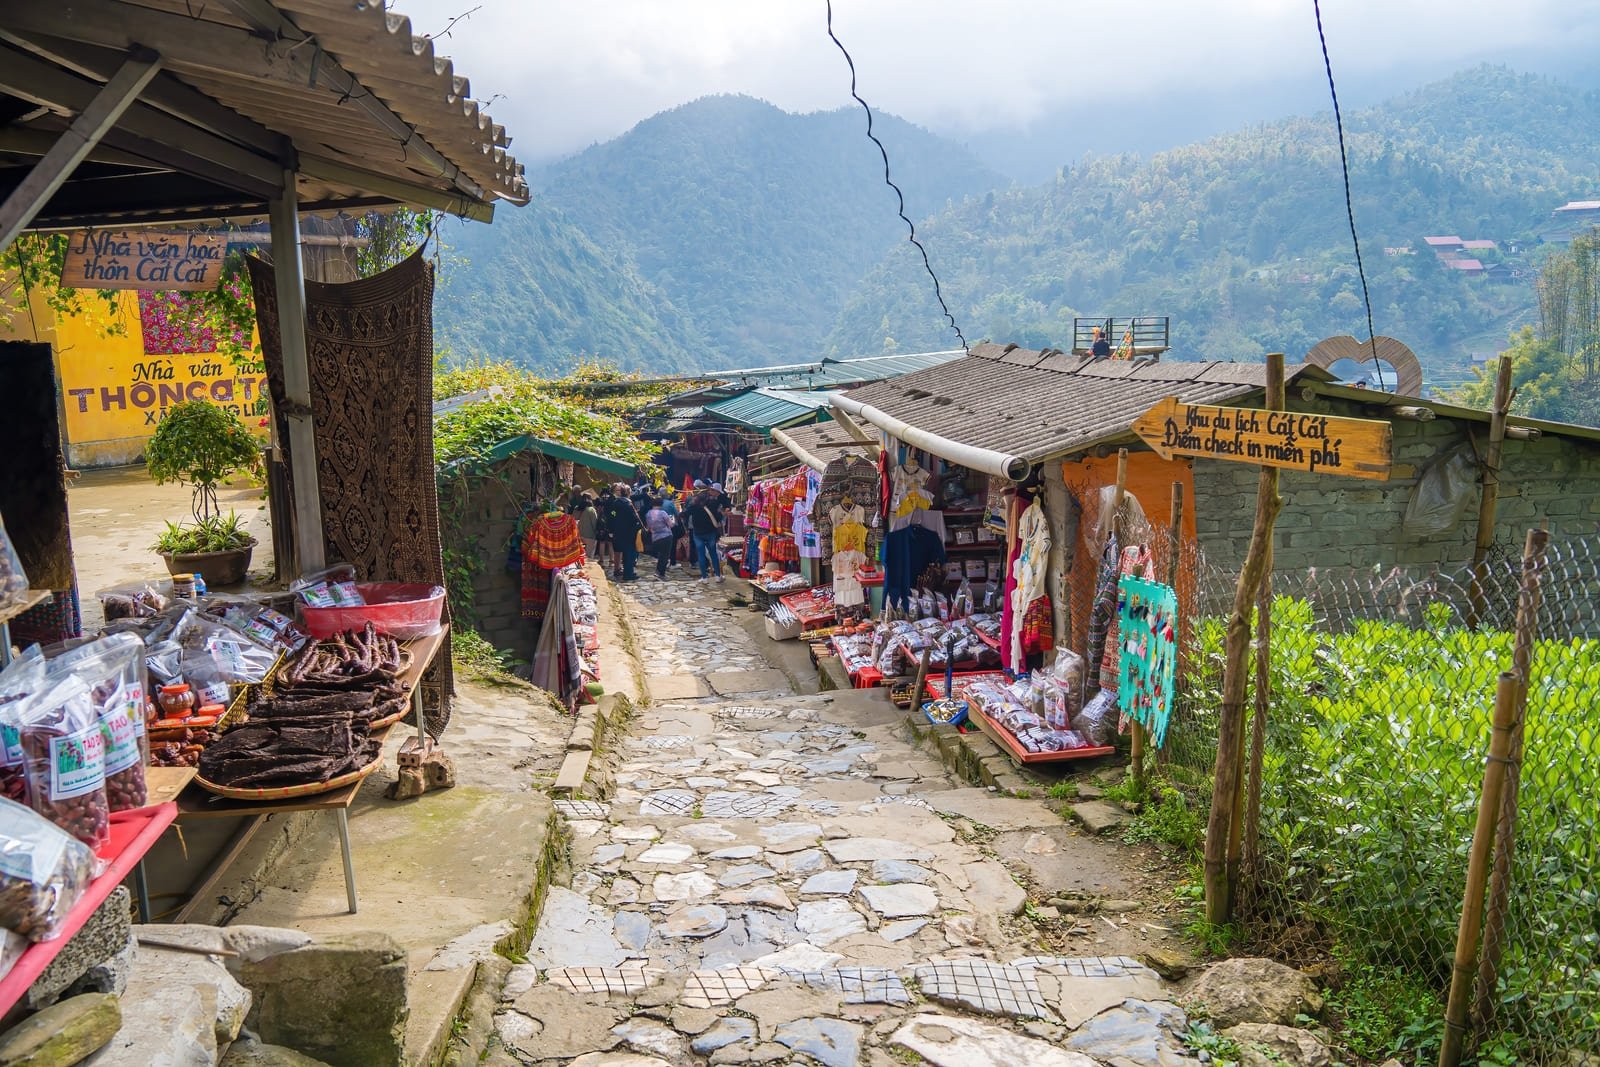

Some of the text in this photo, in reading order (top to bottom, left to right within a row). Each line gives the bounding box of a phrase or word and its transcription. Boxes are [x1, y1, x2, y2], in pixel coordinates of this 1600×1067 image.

[137, 237, 180, 259] văn
[83, 258, 208, 283] thôn Cát Cát
[133, 359, 175, 381] Nhà
[188, 359, 224, 377] văn
[69, 381, 184, 413] THÔN
[1186, 405, 1328, 439] Khu du lịch Cát Cát
[1161, 417, 1342, 472] Điểm check in miễn phí
